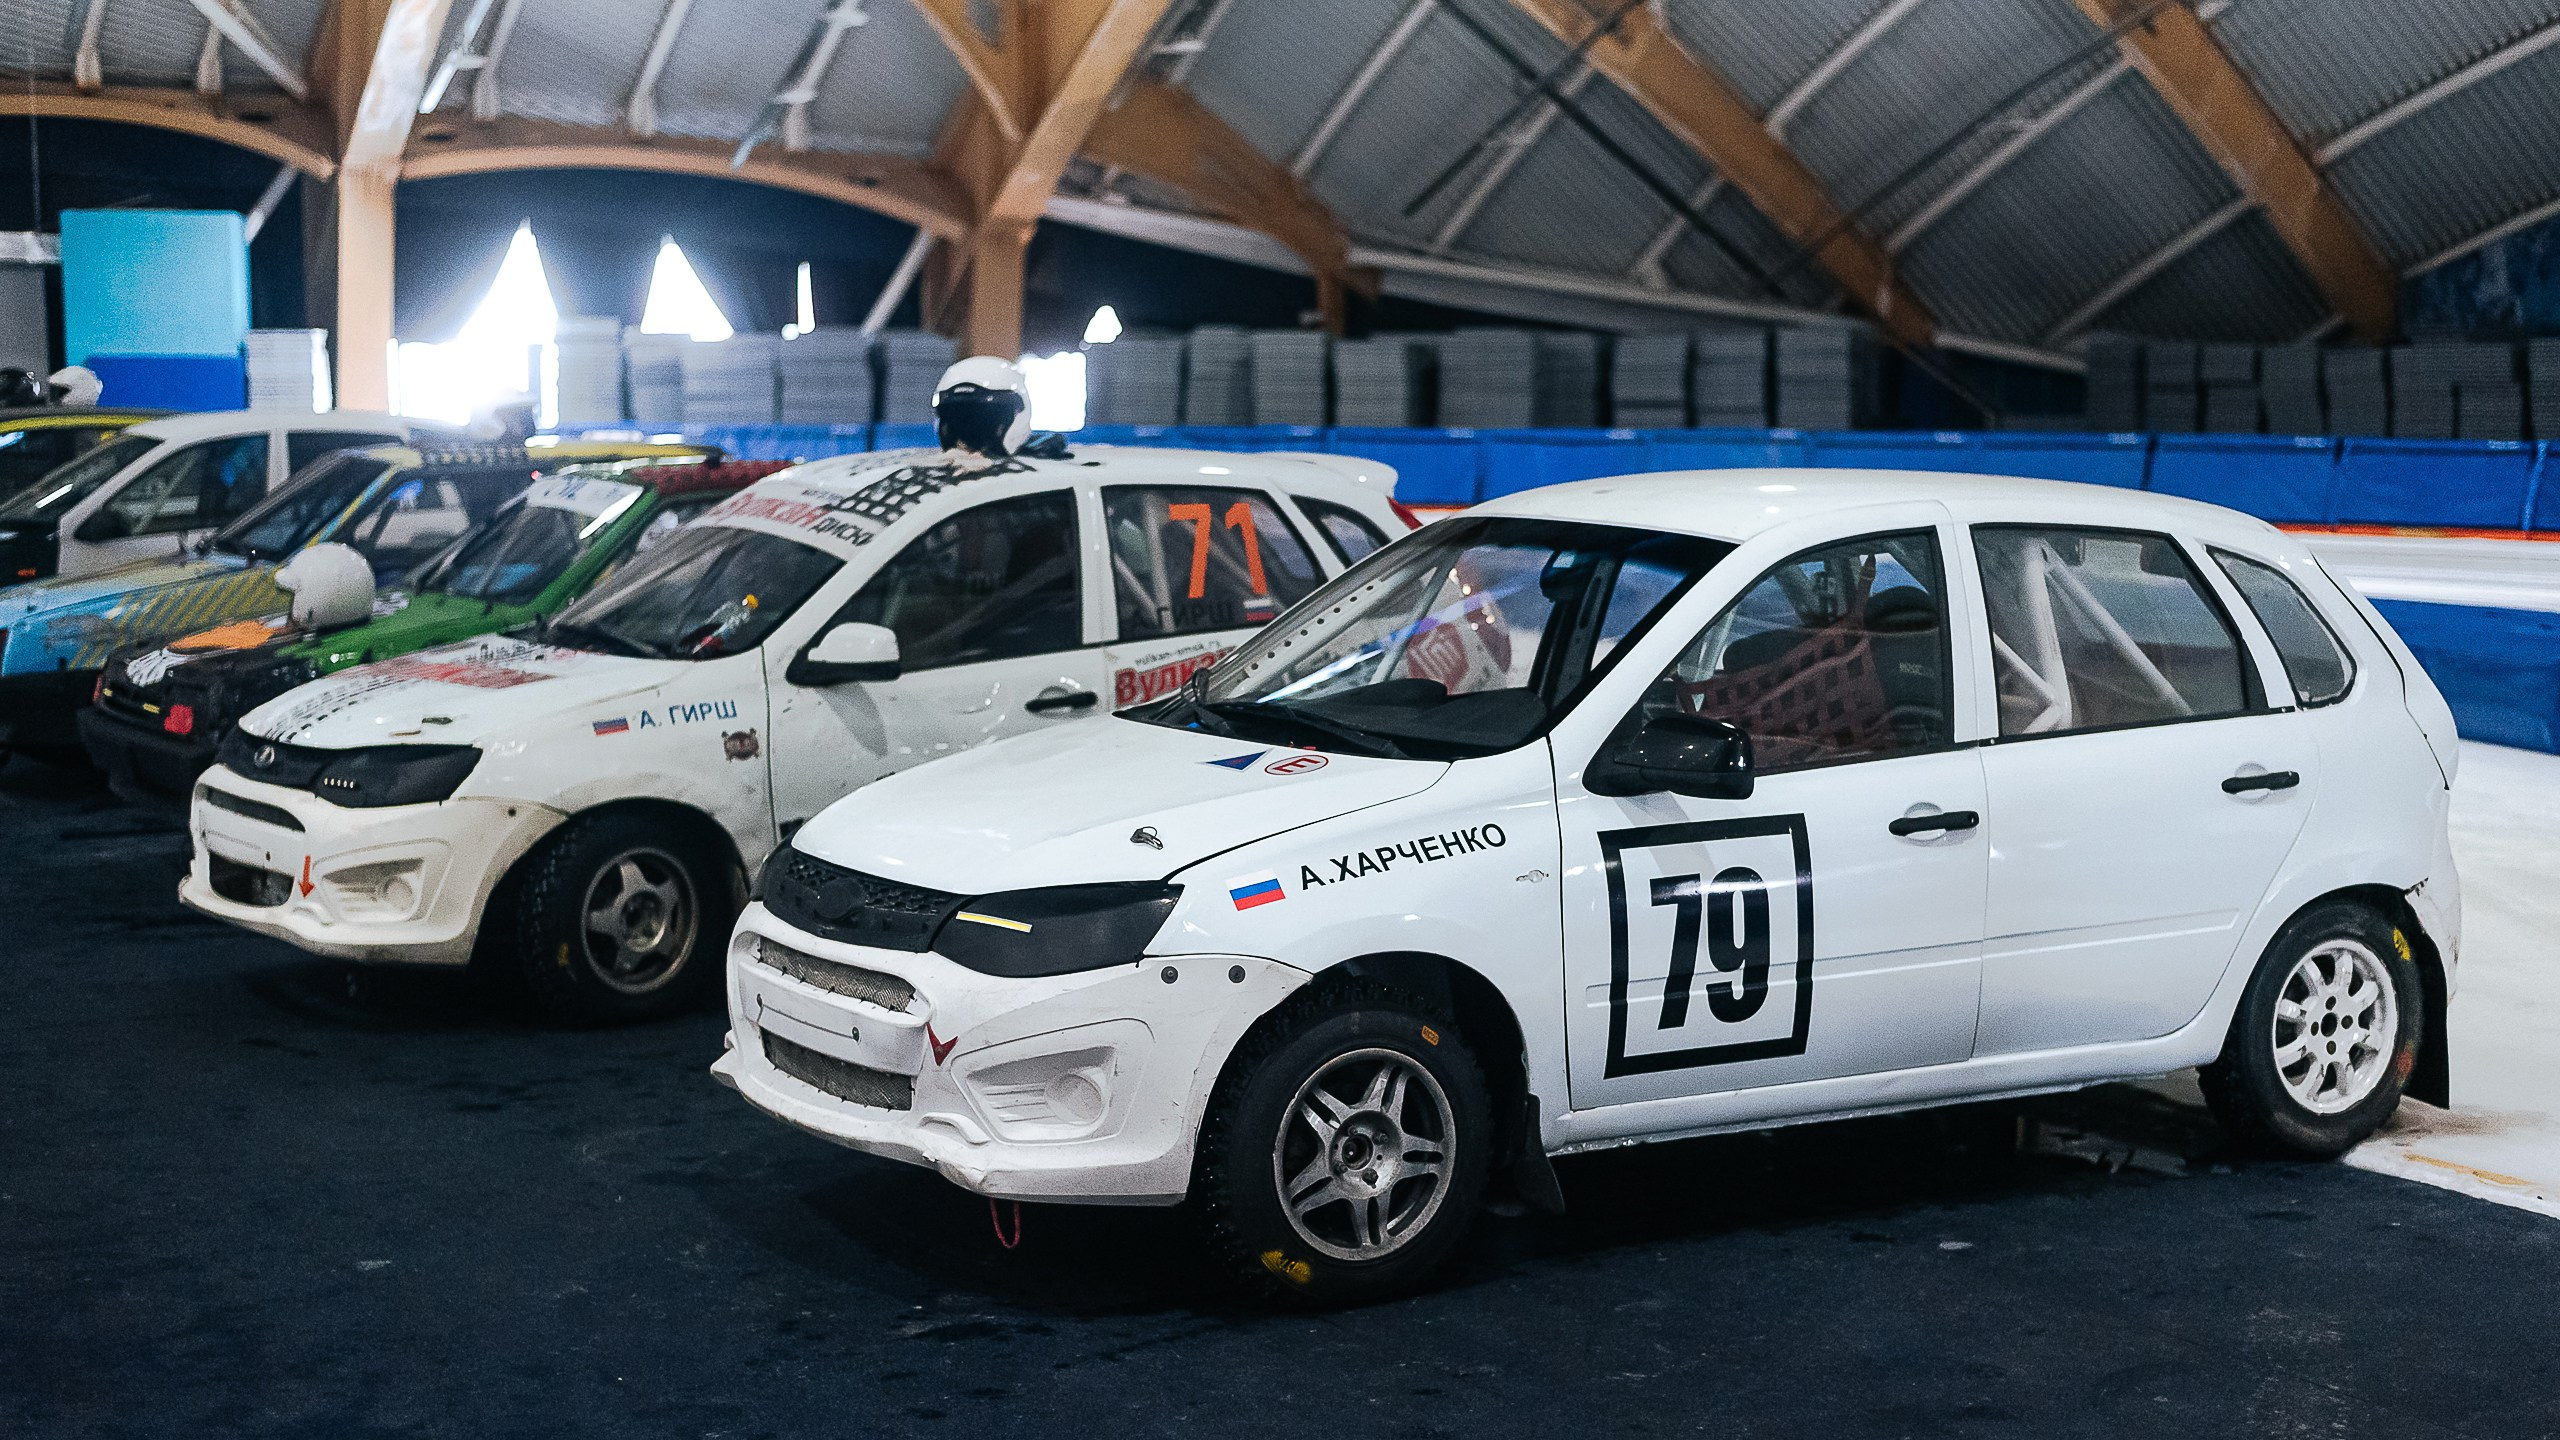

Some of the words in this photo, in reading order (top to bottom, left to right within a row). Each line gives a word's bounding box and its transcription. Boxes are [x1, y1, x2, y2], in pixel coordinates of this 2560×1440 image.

[1168, 503, 1268, 598] 71
[668, 699, 738, 725] ГИРШ
[1300, 823, 1507, 891] А.ХАРЧЕНКО
[1649, 866, 1771, 1030] 79
